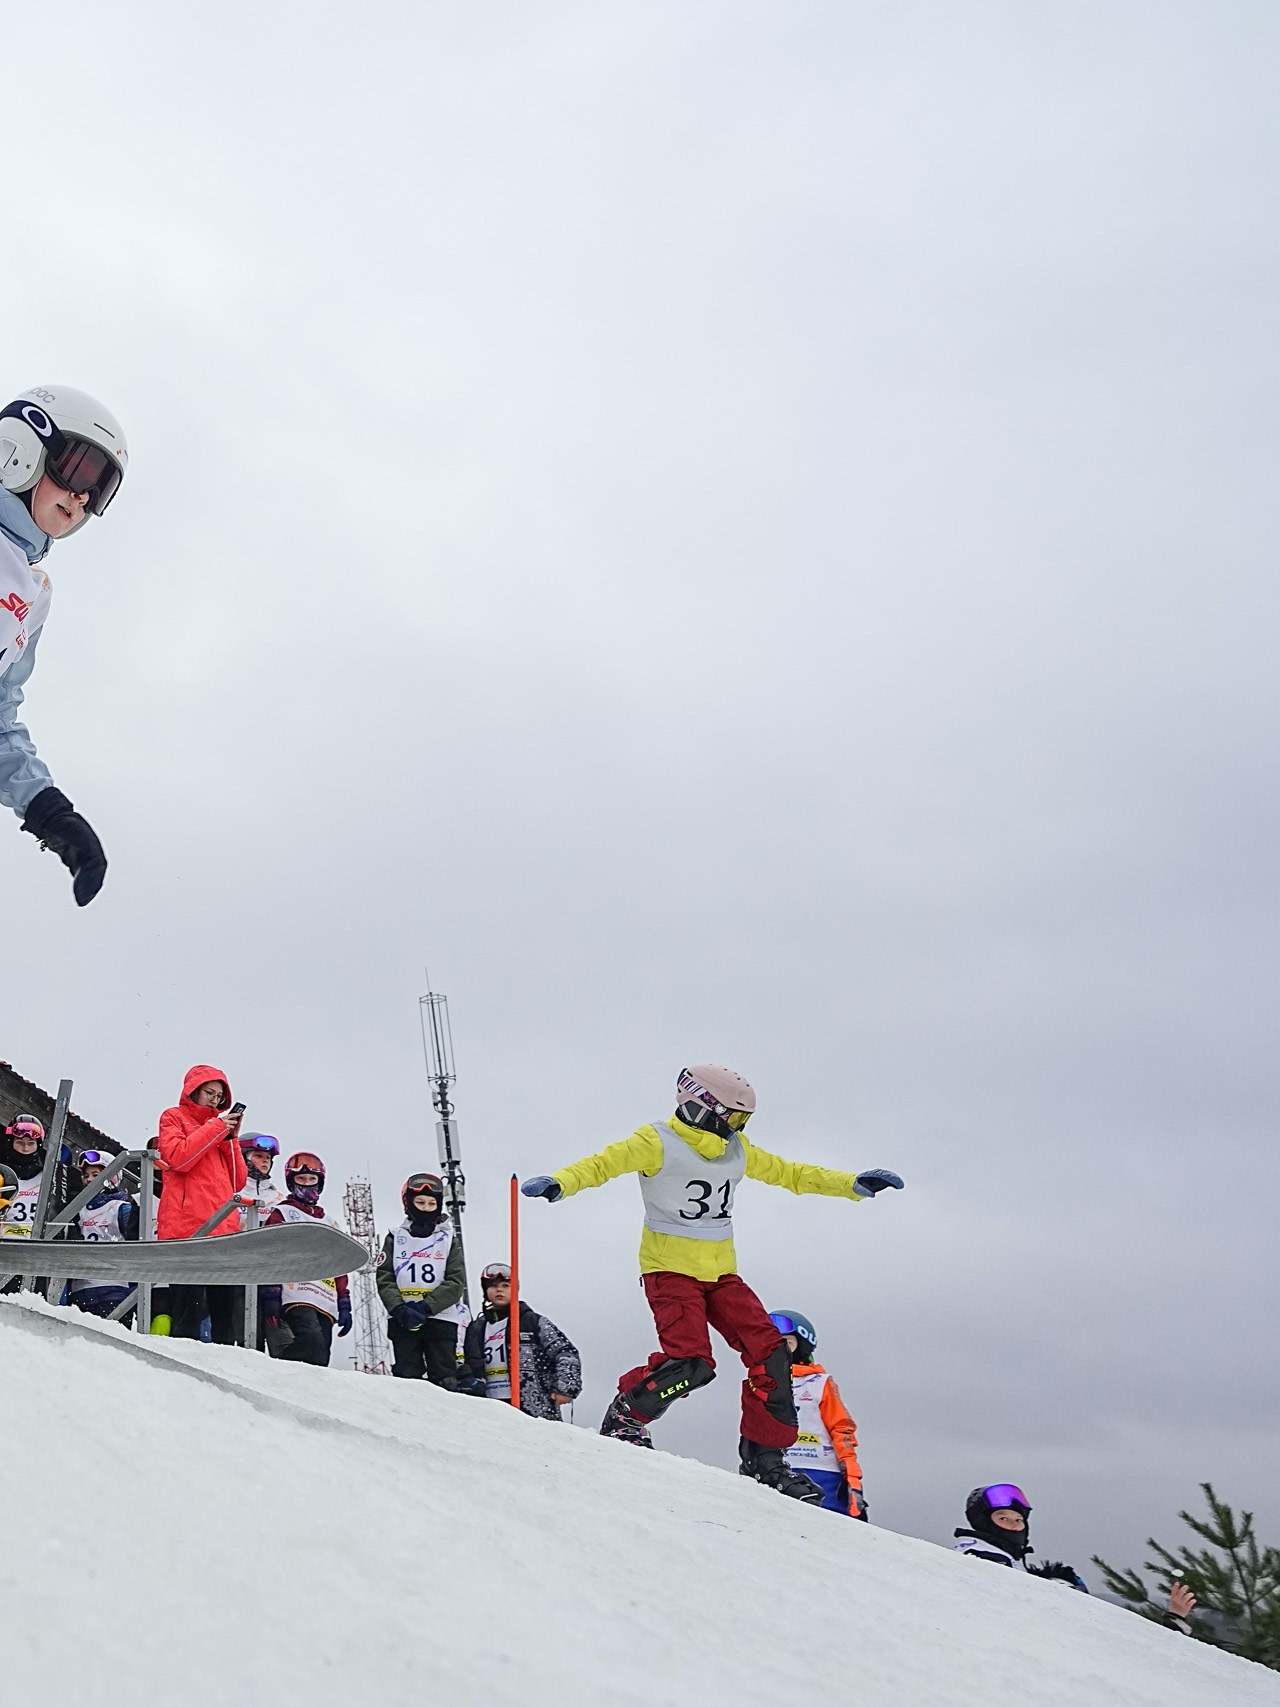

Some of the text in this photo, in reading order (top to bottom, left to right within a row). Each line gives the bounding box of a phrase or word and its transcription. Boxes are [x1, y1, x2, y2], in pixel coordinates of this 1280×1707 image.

[678, 1178, 733, 1221] 31
[406, 1262, 436, 1284] 18
[484, 1343, 506, 1365] 31
[659, 1379, 690, 1399] LEKI
